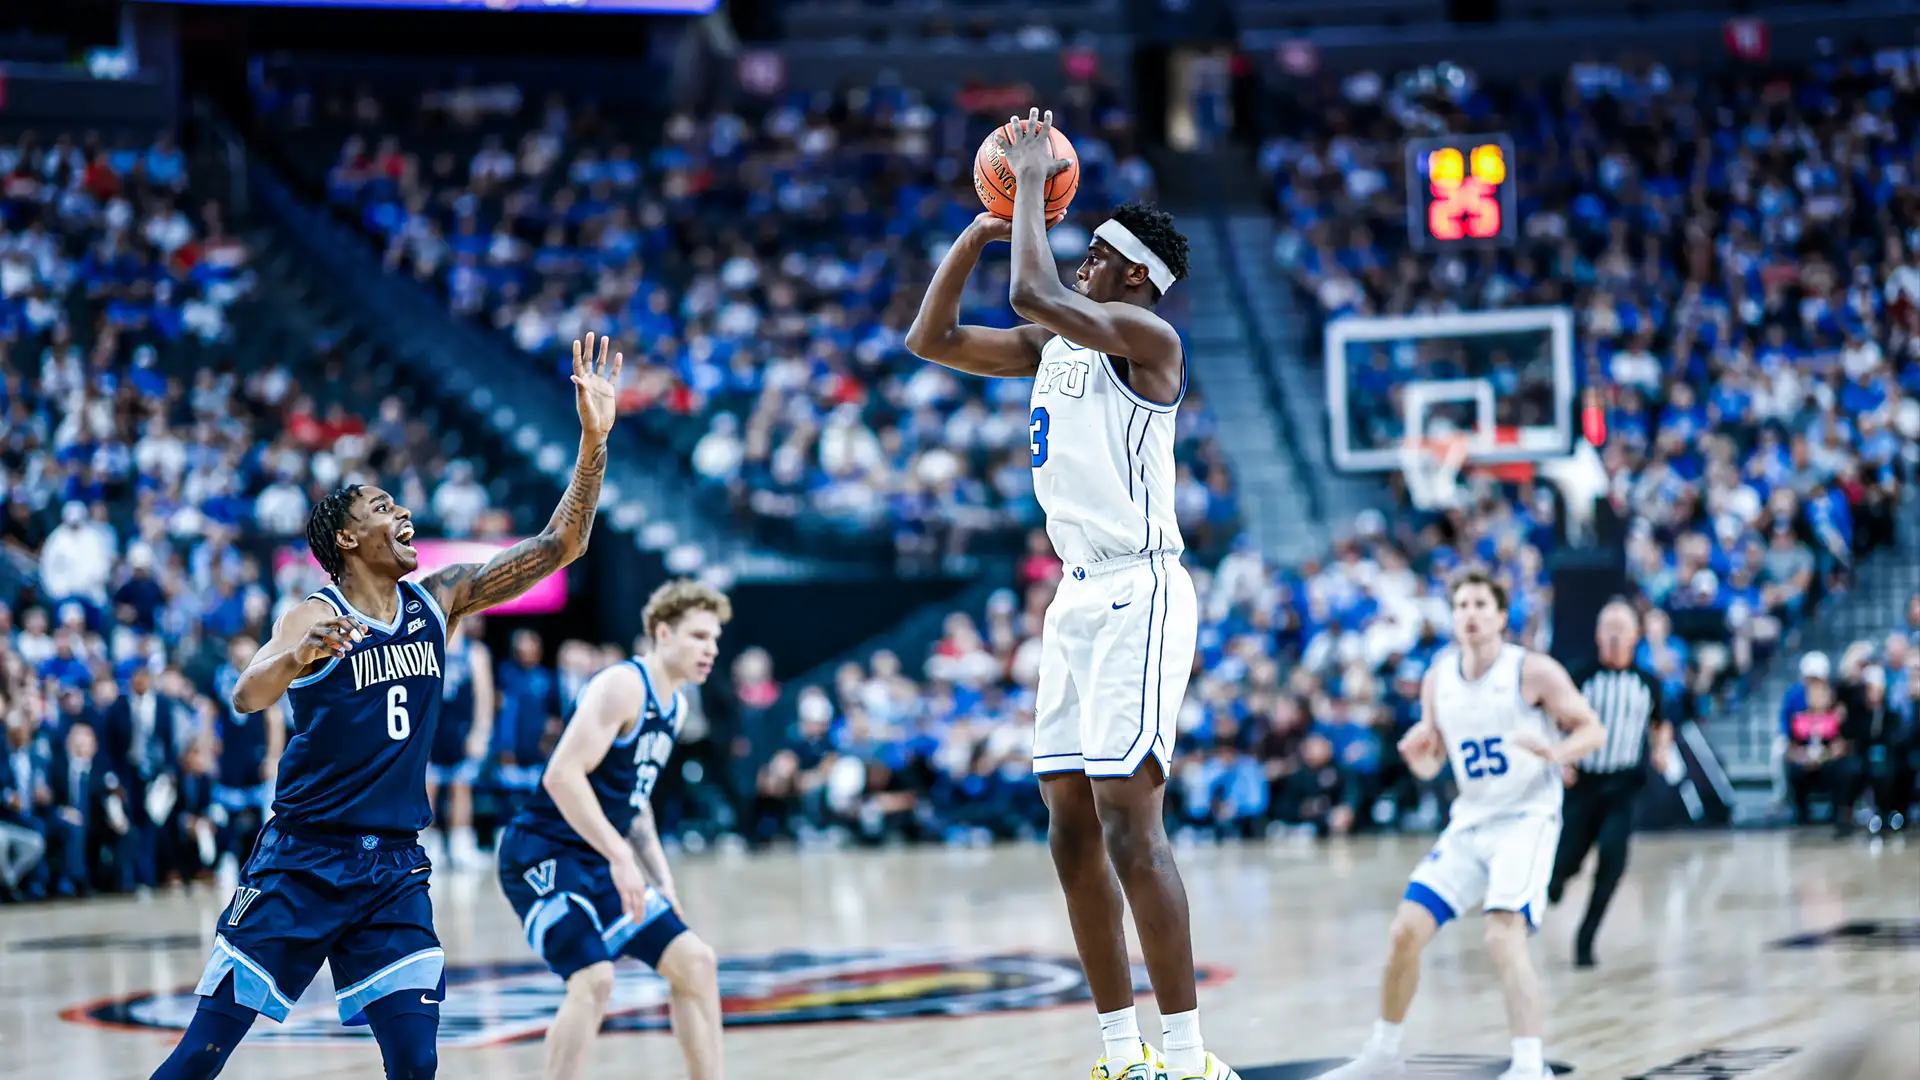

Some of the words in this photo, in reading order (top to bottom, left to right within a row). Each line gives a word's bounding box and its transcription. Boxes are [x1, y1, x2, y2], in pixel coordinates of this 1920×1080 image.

[1029, 407, 1050, 468] 3
[350, 641, 441, 691] VILLANOVA
[387, 685, 410, 740] 6
[1461, 736, 1509, 778] 25
[523, 858, 557, 897] V
[227, 886, 262, 926] V
